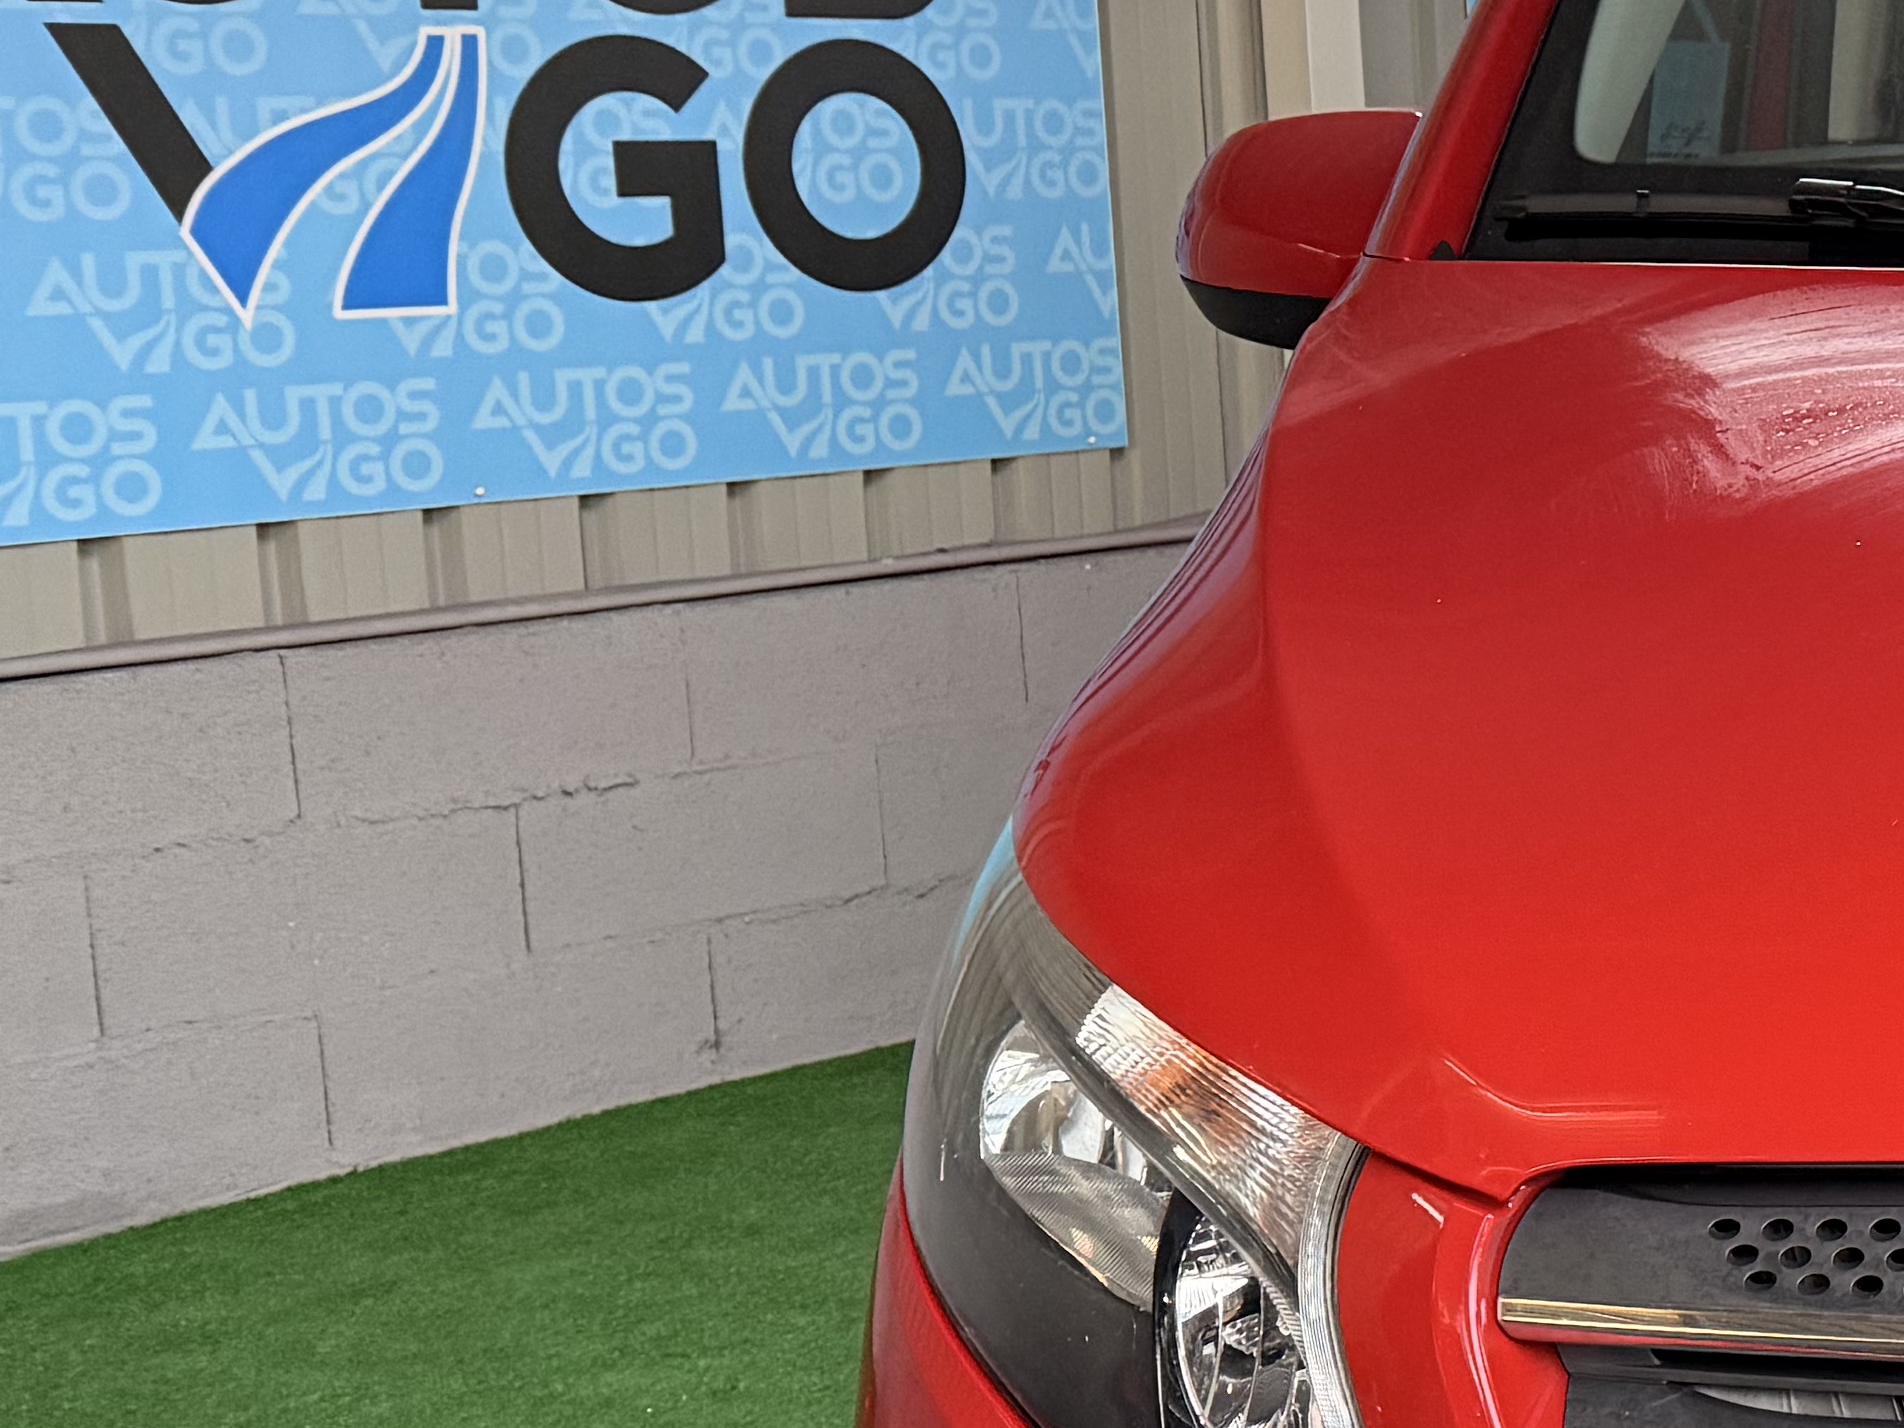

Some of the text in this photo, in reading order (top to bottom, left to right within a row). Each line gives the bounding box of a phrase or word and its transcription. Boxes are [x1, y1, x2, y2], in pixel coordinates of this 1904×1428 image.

[43, 22, 966, 329] VIGO
[85, 308, 297, 373] VIGO
[944, 336, 1121, 397] AUTOS
[470, 360, 694, 430] AUTOS
[721, 347, 918, 412] AUTOS
[192, 376, 442, 451] AUTOS
[764, 402, 924, 460] VIGO
[986, 388, 1126, 441] VIGO
[248, 436, 444, 503] VIGO
[522, 417, 698, 479] VIGO
